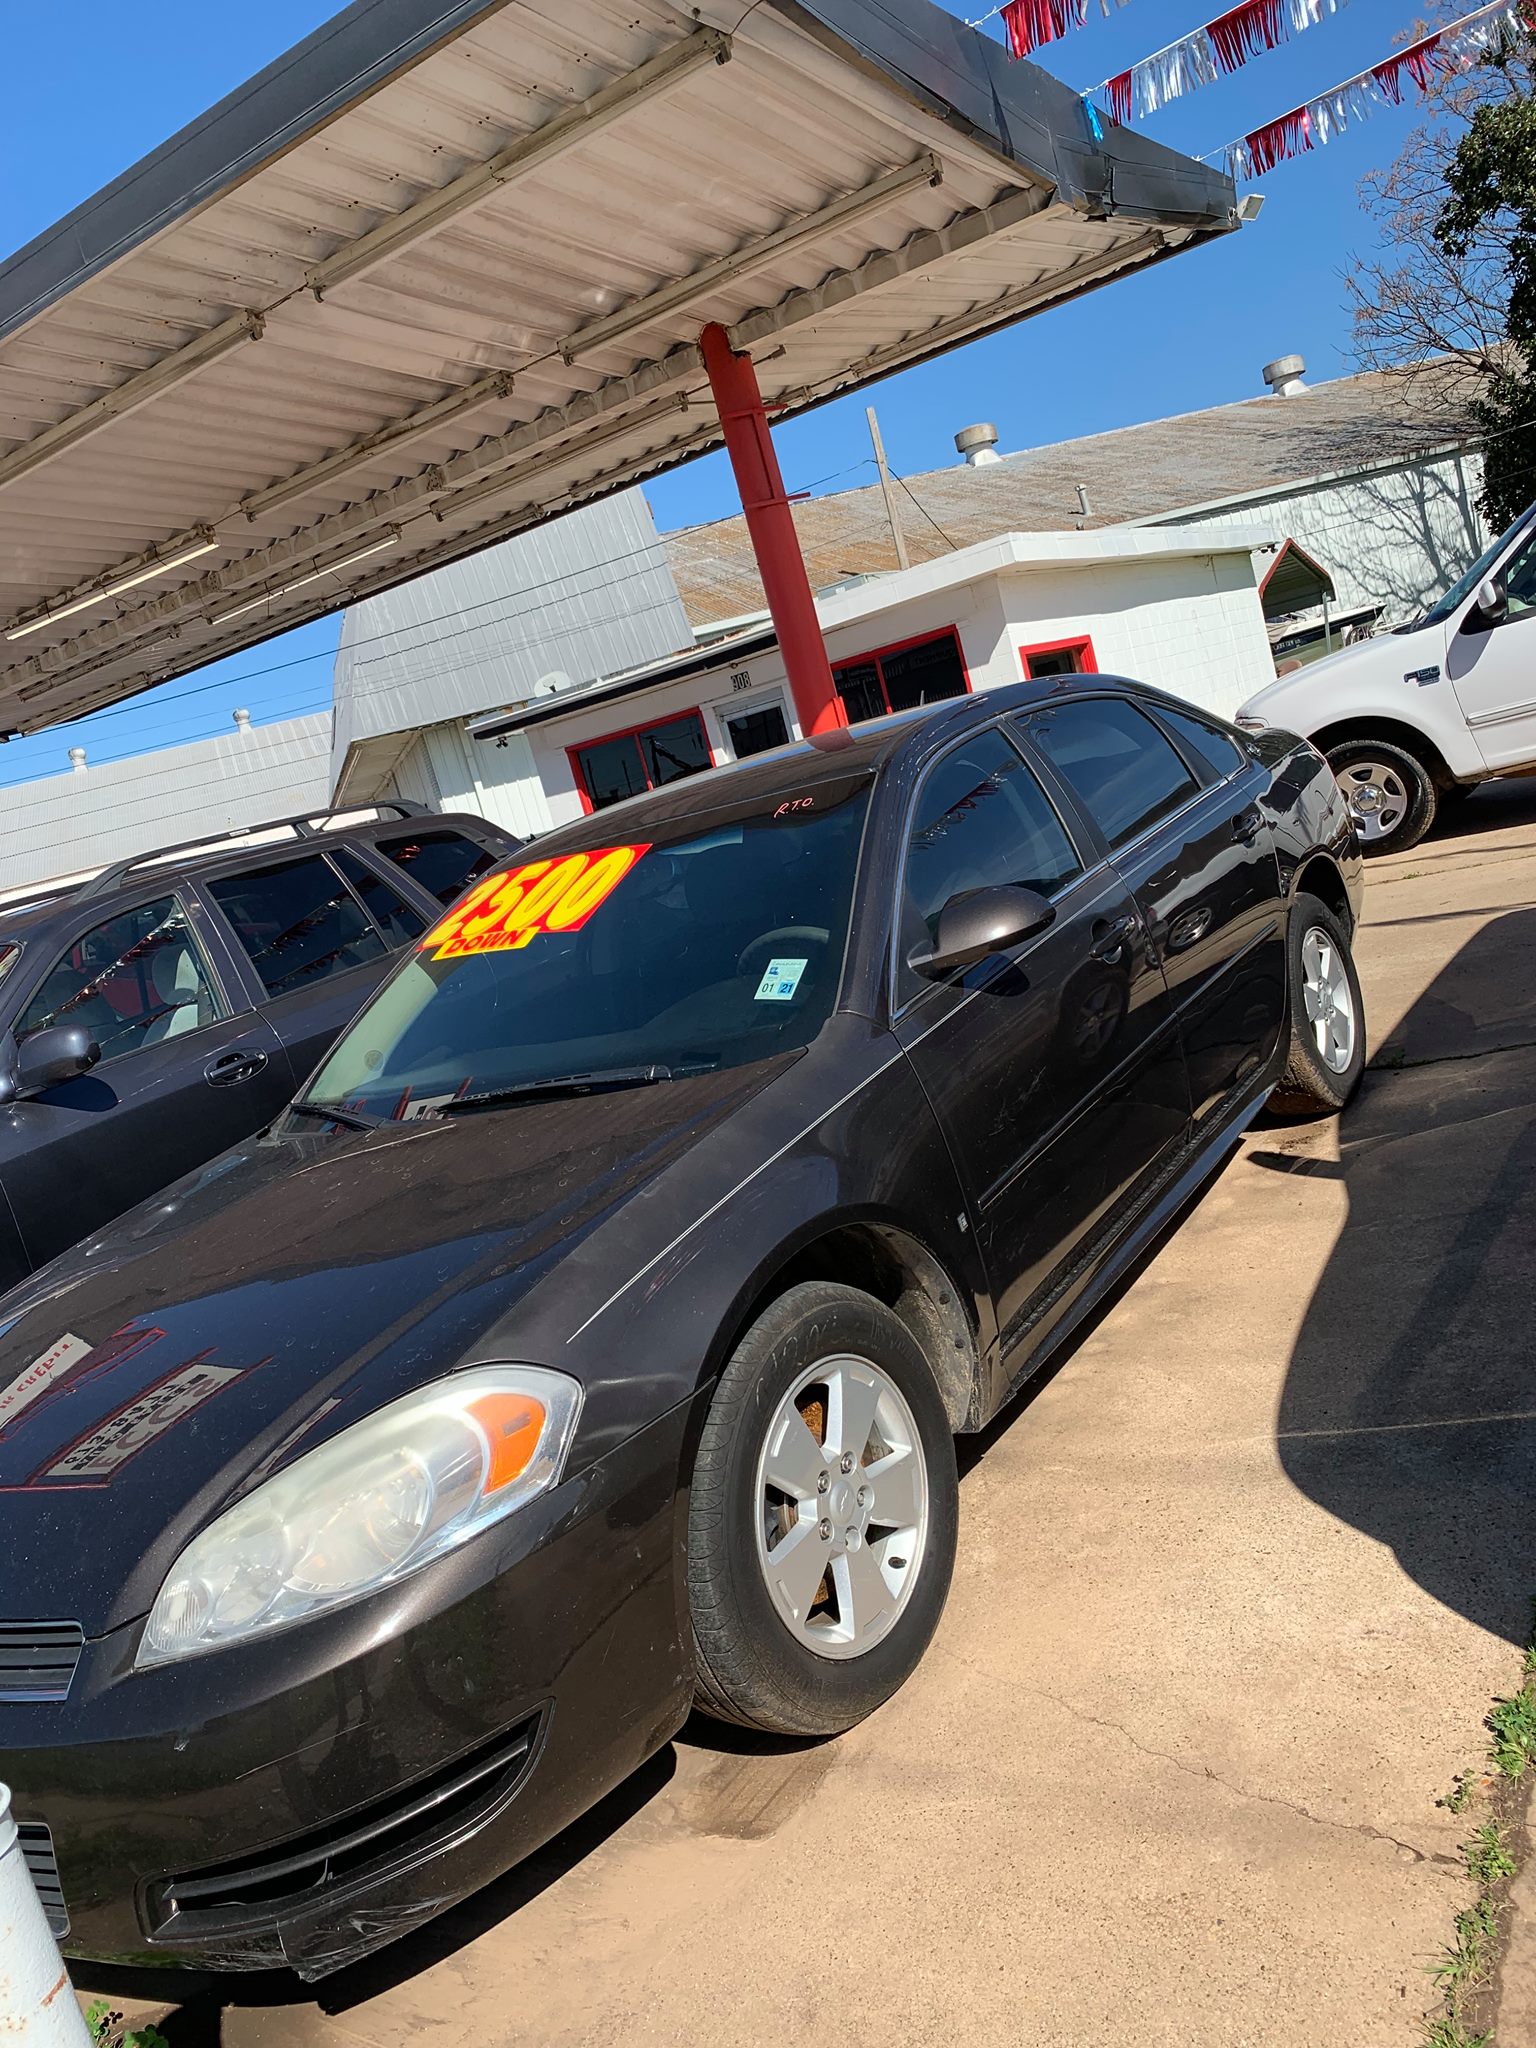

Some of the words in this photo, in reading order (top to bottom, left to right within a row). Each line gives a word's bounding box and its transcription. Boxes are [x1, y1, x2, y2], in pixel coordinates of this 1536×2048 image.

[773, 797, 815, 818] R.T.O.
[423, 847, 636, 948] 2500
[442, 928, 528, 956] DOWN
[761, 983, 775, 993] 01
[780, 983, 794, 994] 21
